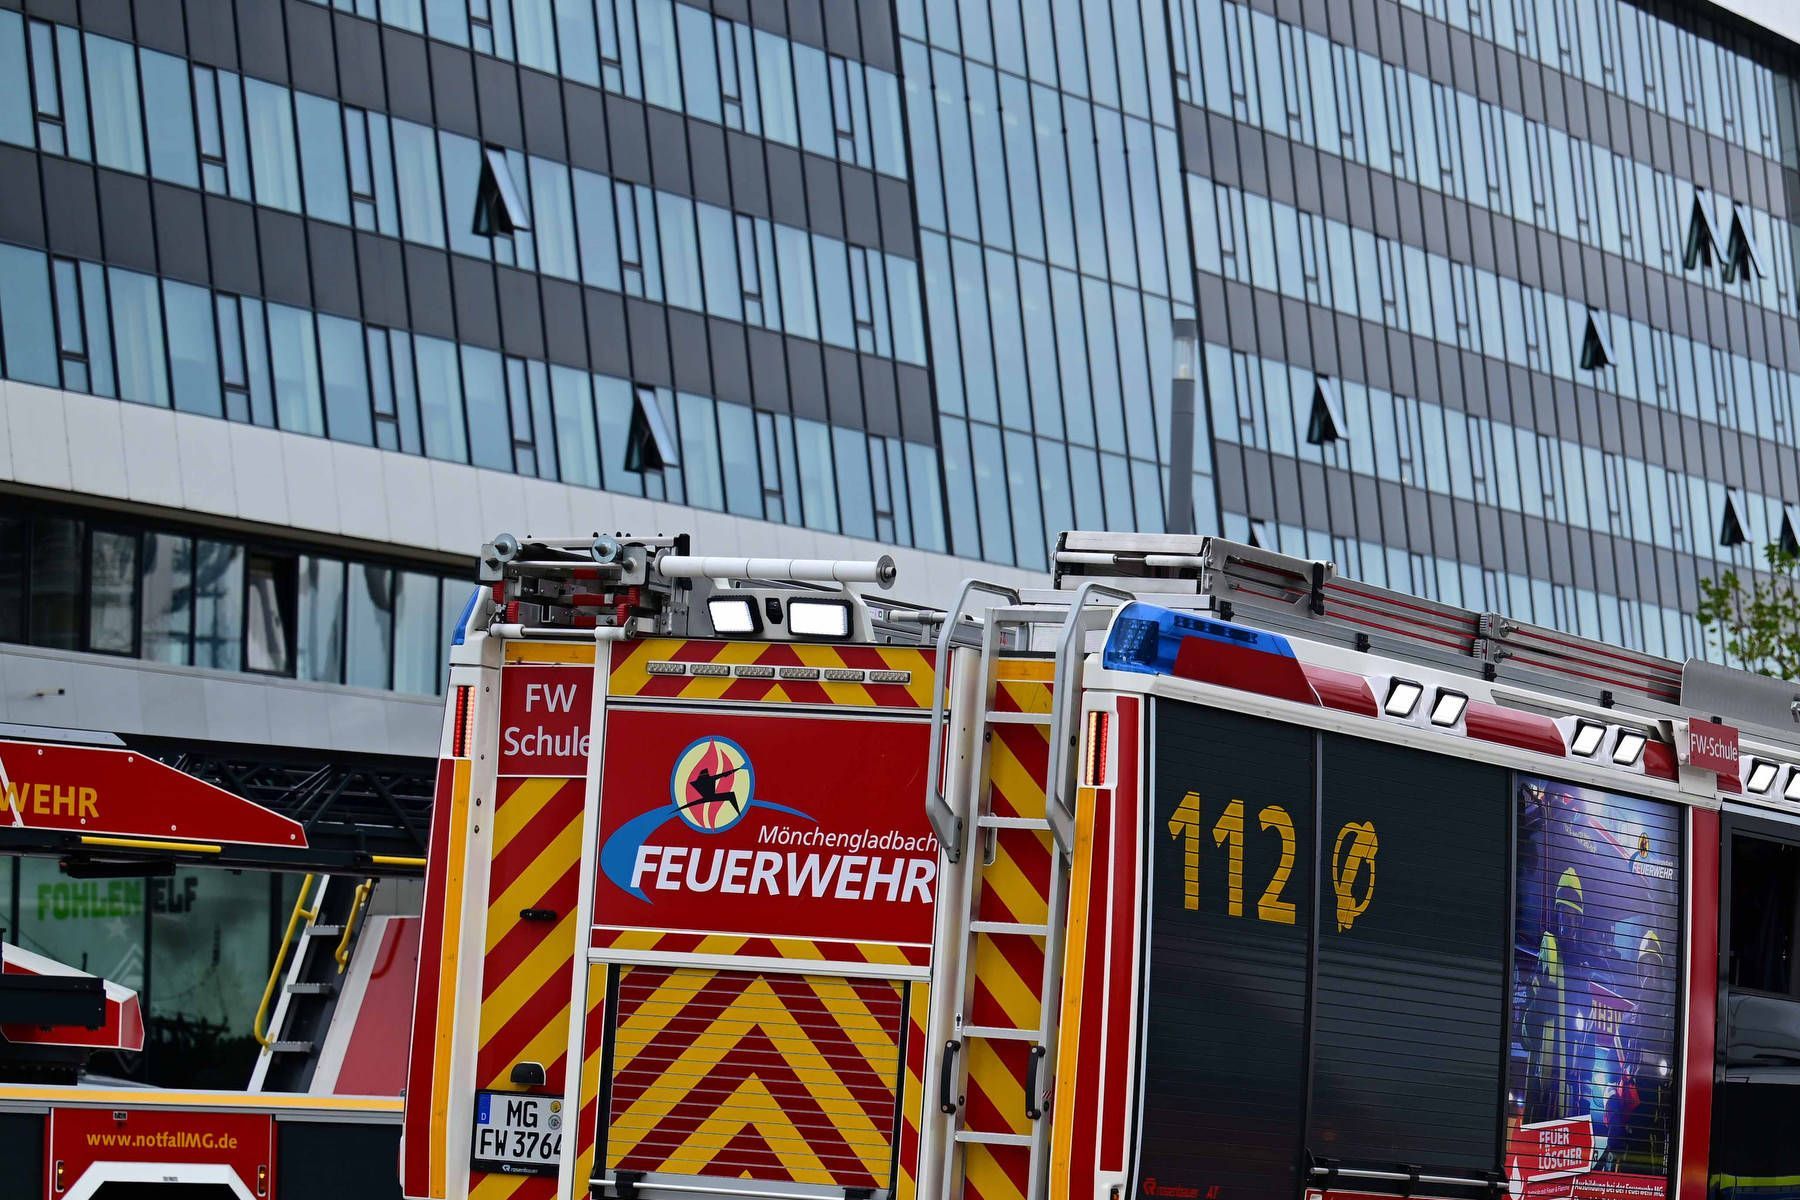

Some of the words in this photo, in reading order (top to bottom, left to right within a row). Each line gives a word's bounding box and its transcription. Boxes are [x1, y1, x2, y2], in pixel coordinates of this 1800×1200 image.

[525, 683, 577, 713] FW
[503, 725, 591, 758] Schule
[1690, 732, 1738, 762] FW-Schule
[757, 824, 940, 853] Mönchengladbach
[1167, 790, 1297, 925] 112
[630, 844, 937, 904] FEUERWEHR
[506, 1099, 538, 1128] MG
[86, 1131, 239, 1149] www.notfallMG.de
[480, 1128, 508, 1157] FW
[1539, 1127, 1570, 1149] FEUER
[1538, 1147, 1583, 1171] LÖSCHER
